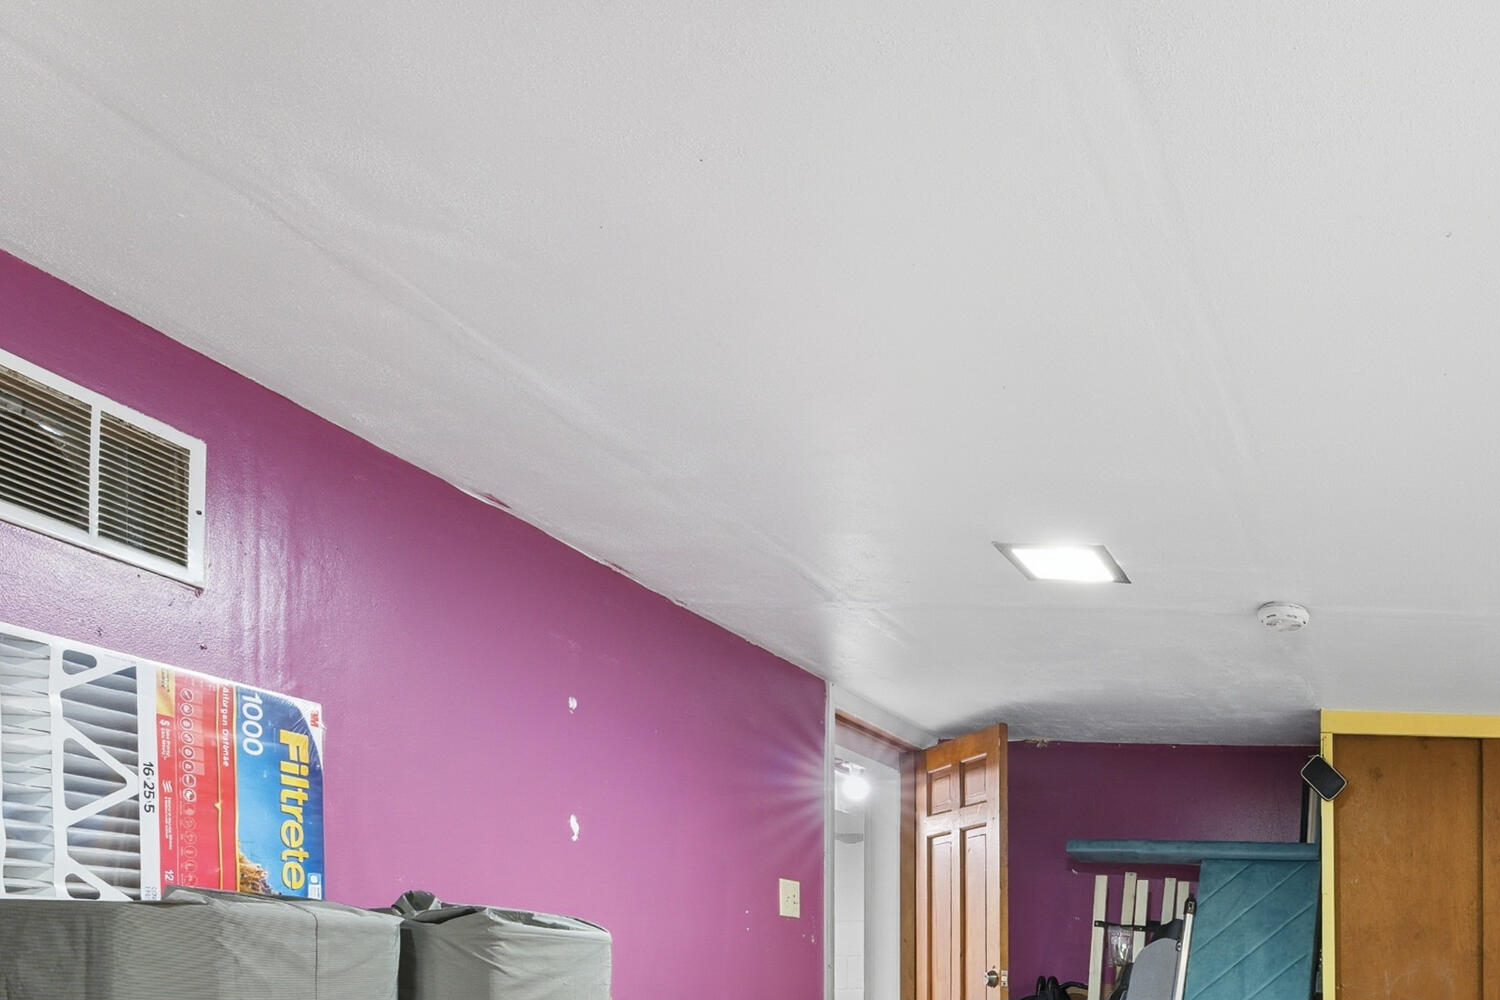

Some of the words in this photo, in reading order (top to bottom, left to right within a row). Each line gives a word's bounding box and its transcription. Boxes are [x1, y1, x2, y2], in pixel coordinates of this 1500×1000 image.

[242, 693, 264, 756] 1000
[310, 711, 319, 728] 3M
[279, 728, 309, 890] Filtrete
